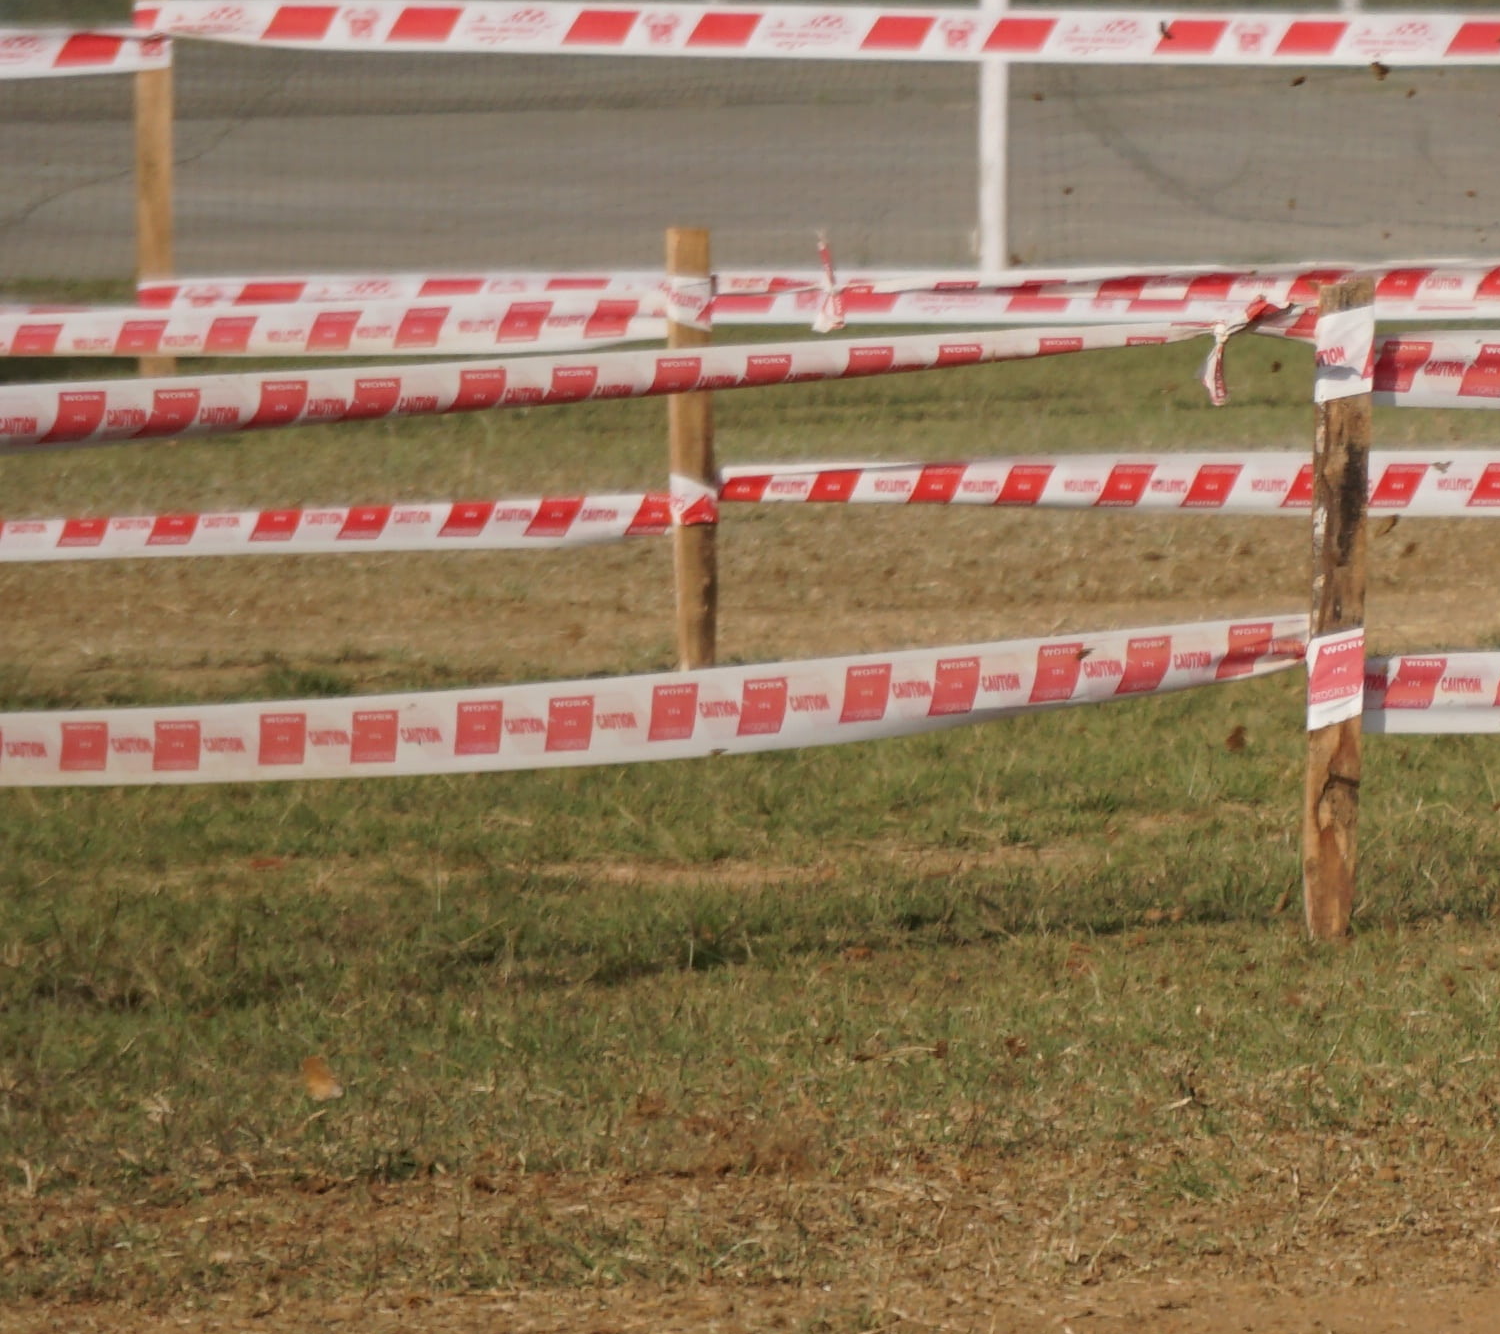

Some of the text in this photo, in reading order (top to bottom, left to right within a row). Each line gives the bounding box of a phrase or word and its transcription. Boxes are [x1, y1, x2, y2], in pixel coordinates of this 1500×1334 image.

[1317, 346, 1345, 366] TION
[1424, 361, 1464, 376] CAUTION
[1323, 639, 1364, 654] WORK
[1441, 677, 1482, 692] CAUTION
